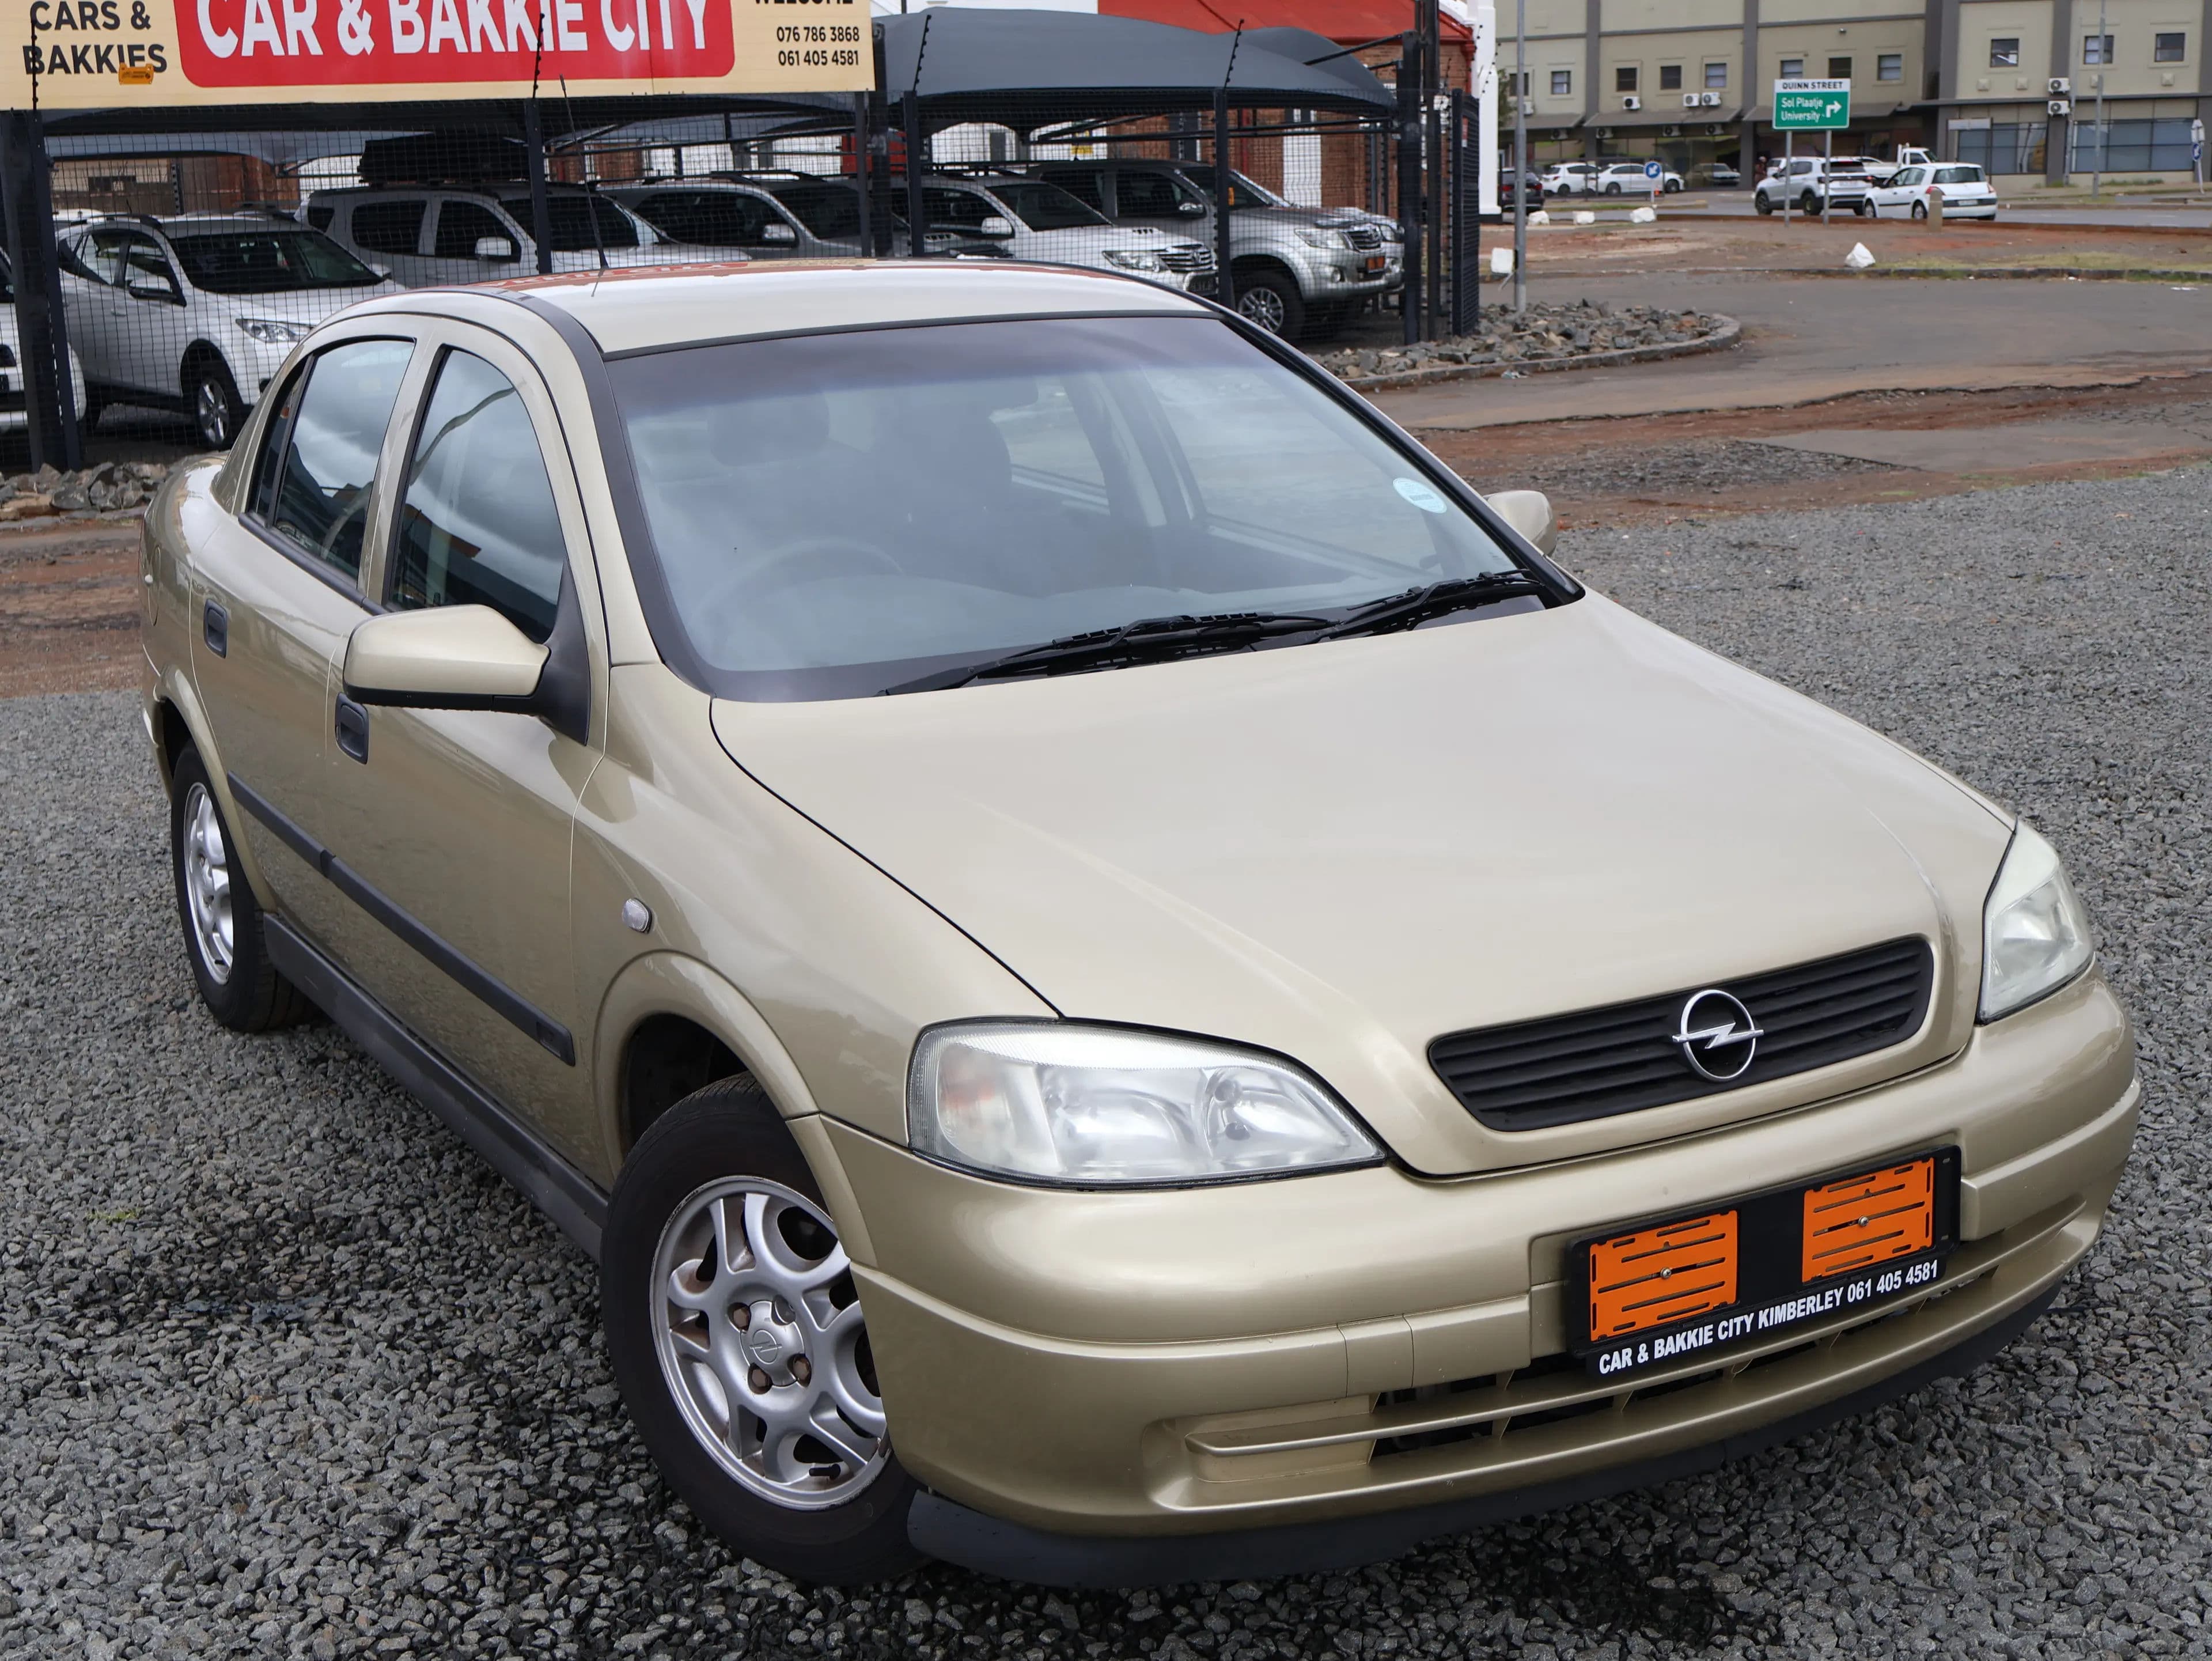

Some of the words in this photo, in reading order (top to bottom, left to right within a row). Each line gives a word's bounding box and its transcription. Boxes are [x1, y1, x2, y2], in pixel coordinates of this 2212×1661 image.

[30, 1, 121, 31] CARS
[131, 1, 151, 30] &
[197, 0, 324, 58] CAR
[338, 0, 375, 56] &
[388, 0, 588, 54] BAKKIE
[600, 0, 707, 52] CITY
[777, 27, 800, 42] 076
[804, 27, 826, 42] 786
[830, 27, 859, 42] 3868
[22, 44, 168, 75] BAKKIES
[778, 50, 800, 66] 061
[804, 50, 828, 66] 405
[831, 50, 859, 66] 4581
[1781, 97, 1794, 108] Sol
[1796, 97, 1824, 109] Plaatje
[1781, 110, 1820, 123] University
[1599, 1348, 1633, 1374] CAR
[1637, 1343, 1649, 1363] &
[1654, 1325, 1714, 1359] BAKKIE
[1718, 1313, 1755, 1340] CITY
[1758, 1287, 1844, 1329] KIMBERLEY
[1847, 1278, 1872, 1303] 061
[1876, 1270, 1902, 1293] 405
[1906, 1259, 1938, 1285] 4581
